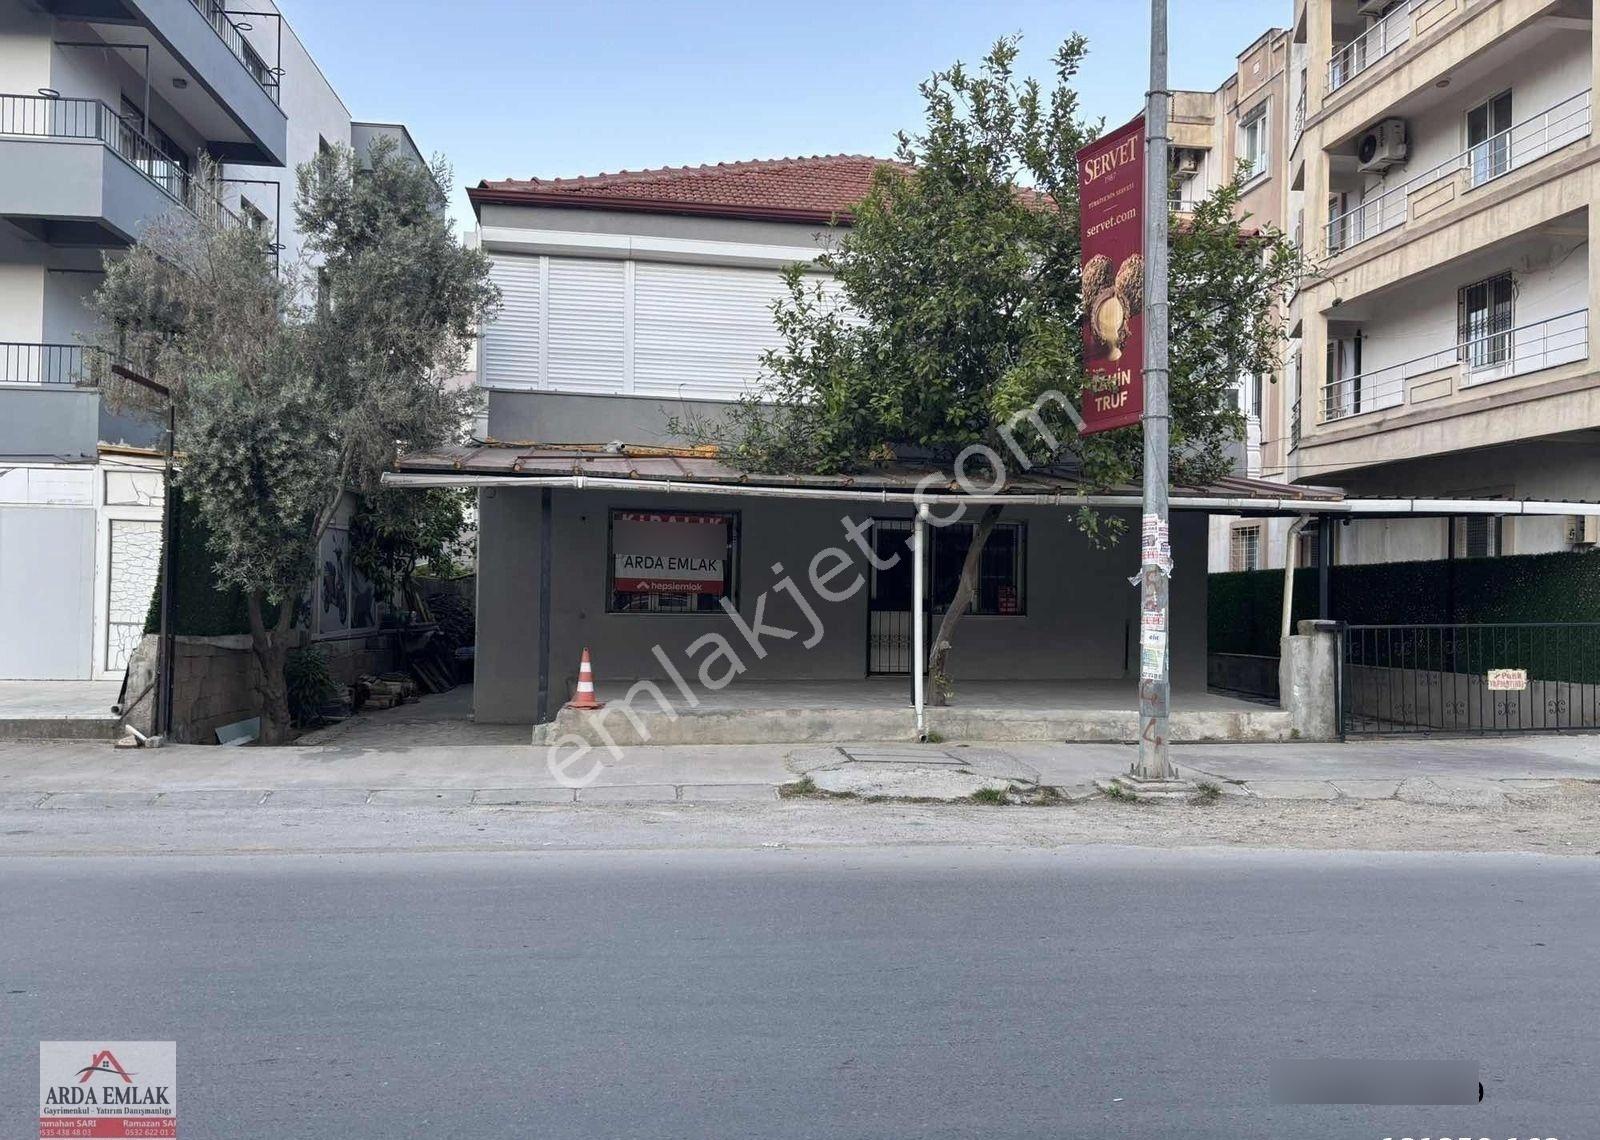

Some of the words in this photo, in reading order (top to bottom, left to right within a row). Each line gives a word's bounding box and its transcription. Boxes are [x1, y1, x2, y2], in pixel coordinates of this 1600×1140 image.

[1084, 135, 1138, 185] SERVET
[1086, 208, 1136, 237] servet.com
[1094, 391, 1128, 412] TRUF
[624, 555, 664, 569] ARDA
[668, 557, 717, 572] EMLAK
